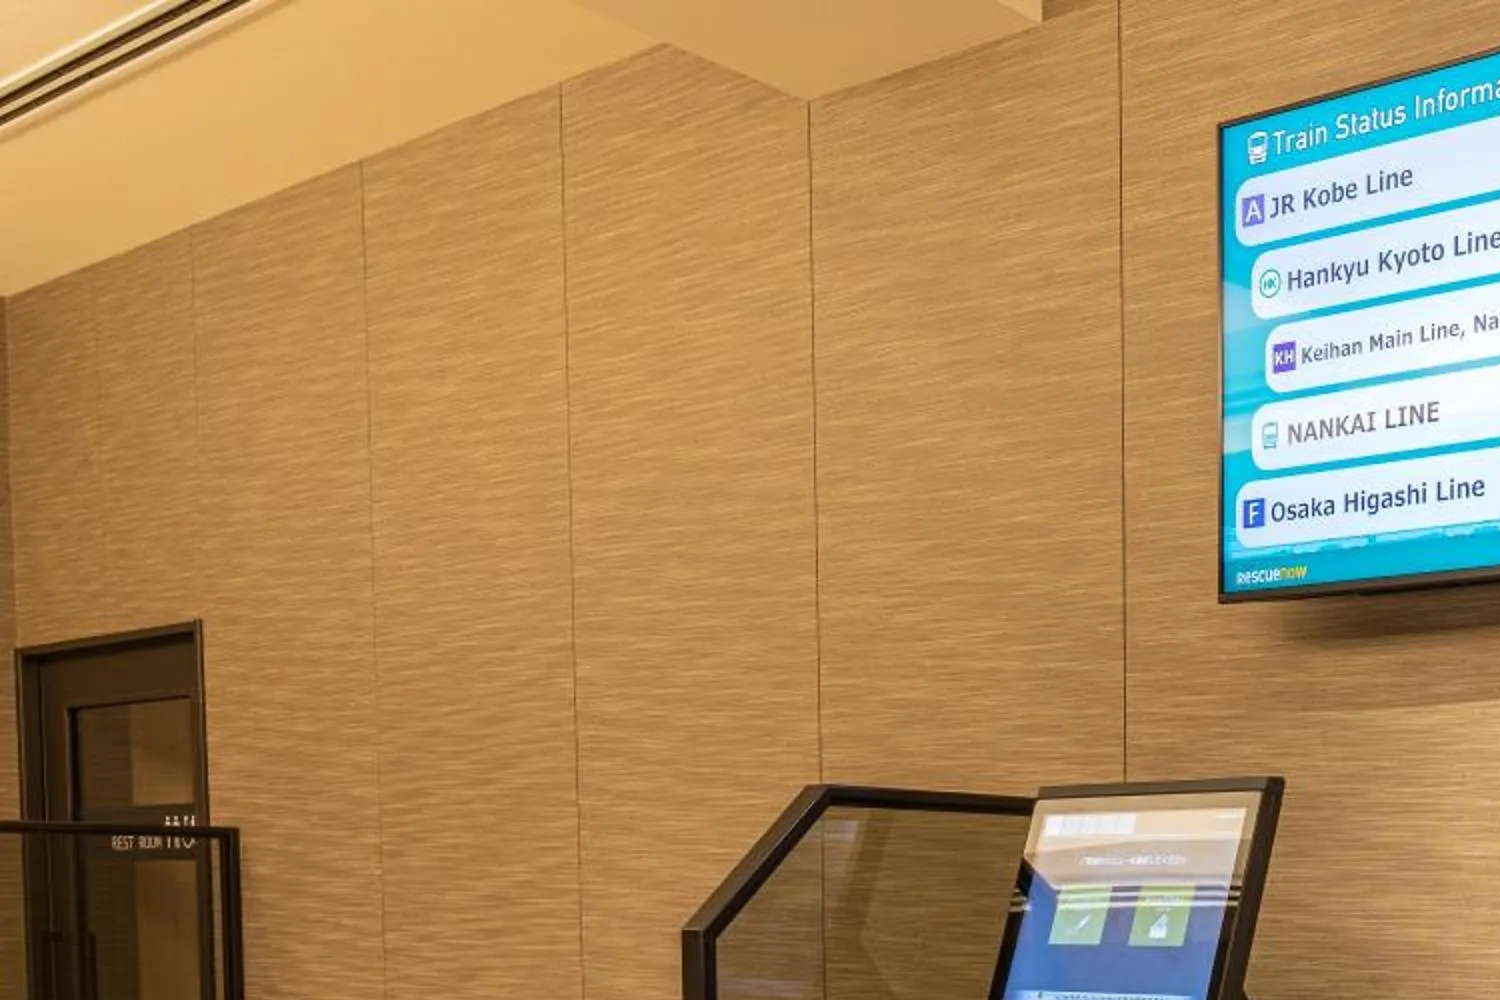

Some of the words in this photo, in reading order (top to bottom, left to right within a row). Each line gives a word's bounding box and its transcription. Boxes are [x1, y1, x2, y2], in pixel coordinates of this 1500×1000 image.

[1273, 122, 1327, 155] Train
[1336, 104, 1406, 139] Status
[1245, 199, 1263, 224] A
[1270, 194, 1295, 219] JR
[1303, 180, 1357, 210] Kobe
[1366, 166, 1413, 195] Line
[1287, 257, 1369, 291] Hankyu
[1379, 240, 1444, 273] Kyoto
[1274, 346, 1294, 368] KH
[1301, 341, 1362, 365] Keihan
[1369, 330, 1413, 352] Main
[1420, 319, 1465, 343] Line,
[1287, 410, 1377, 444] NANKAI
[1385, 402, 1439, 430] LINE
[1271, 495, 1335, 523] Osaka
[1344, 482, 1428, 515] Higashi
[1436, 477, 1486, 503] Line
